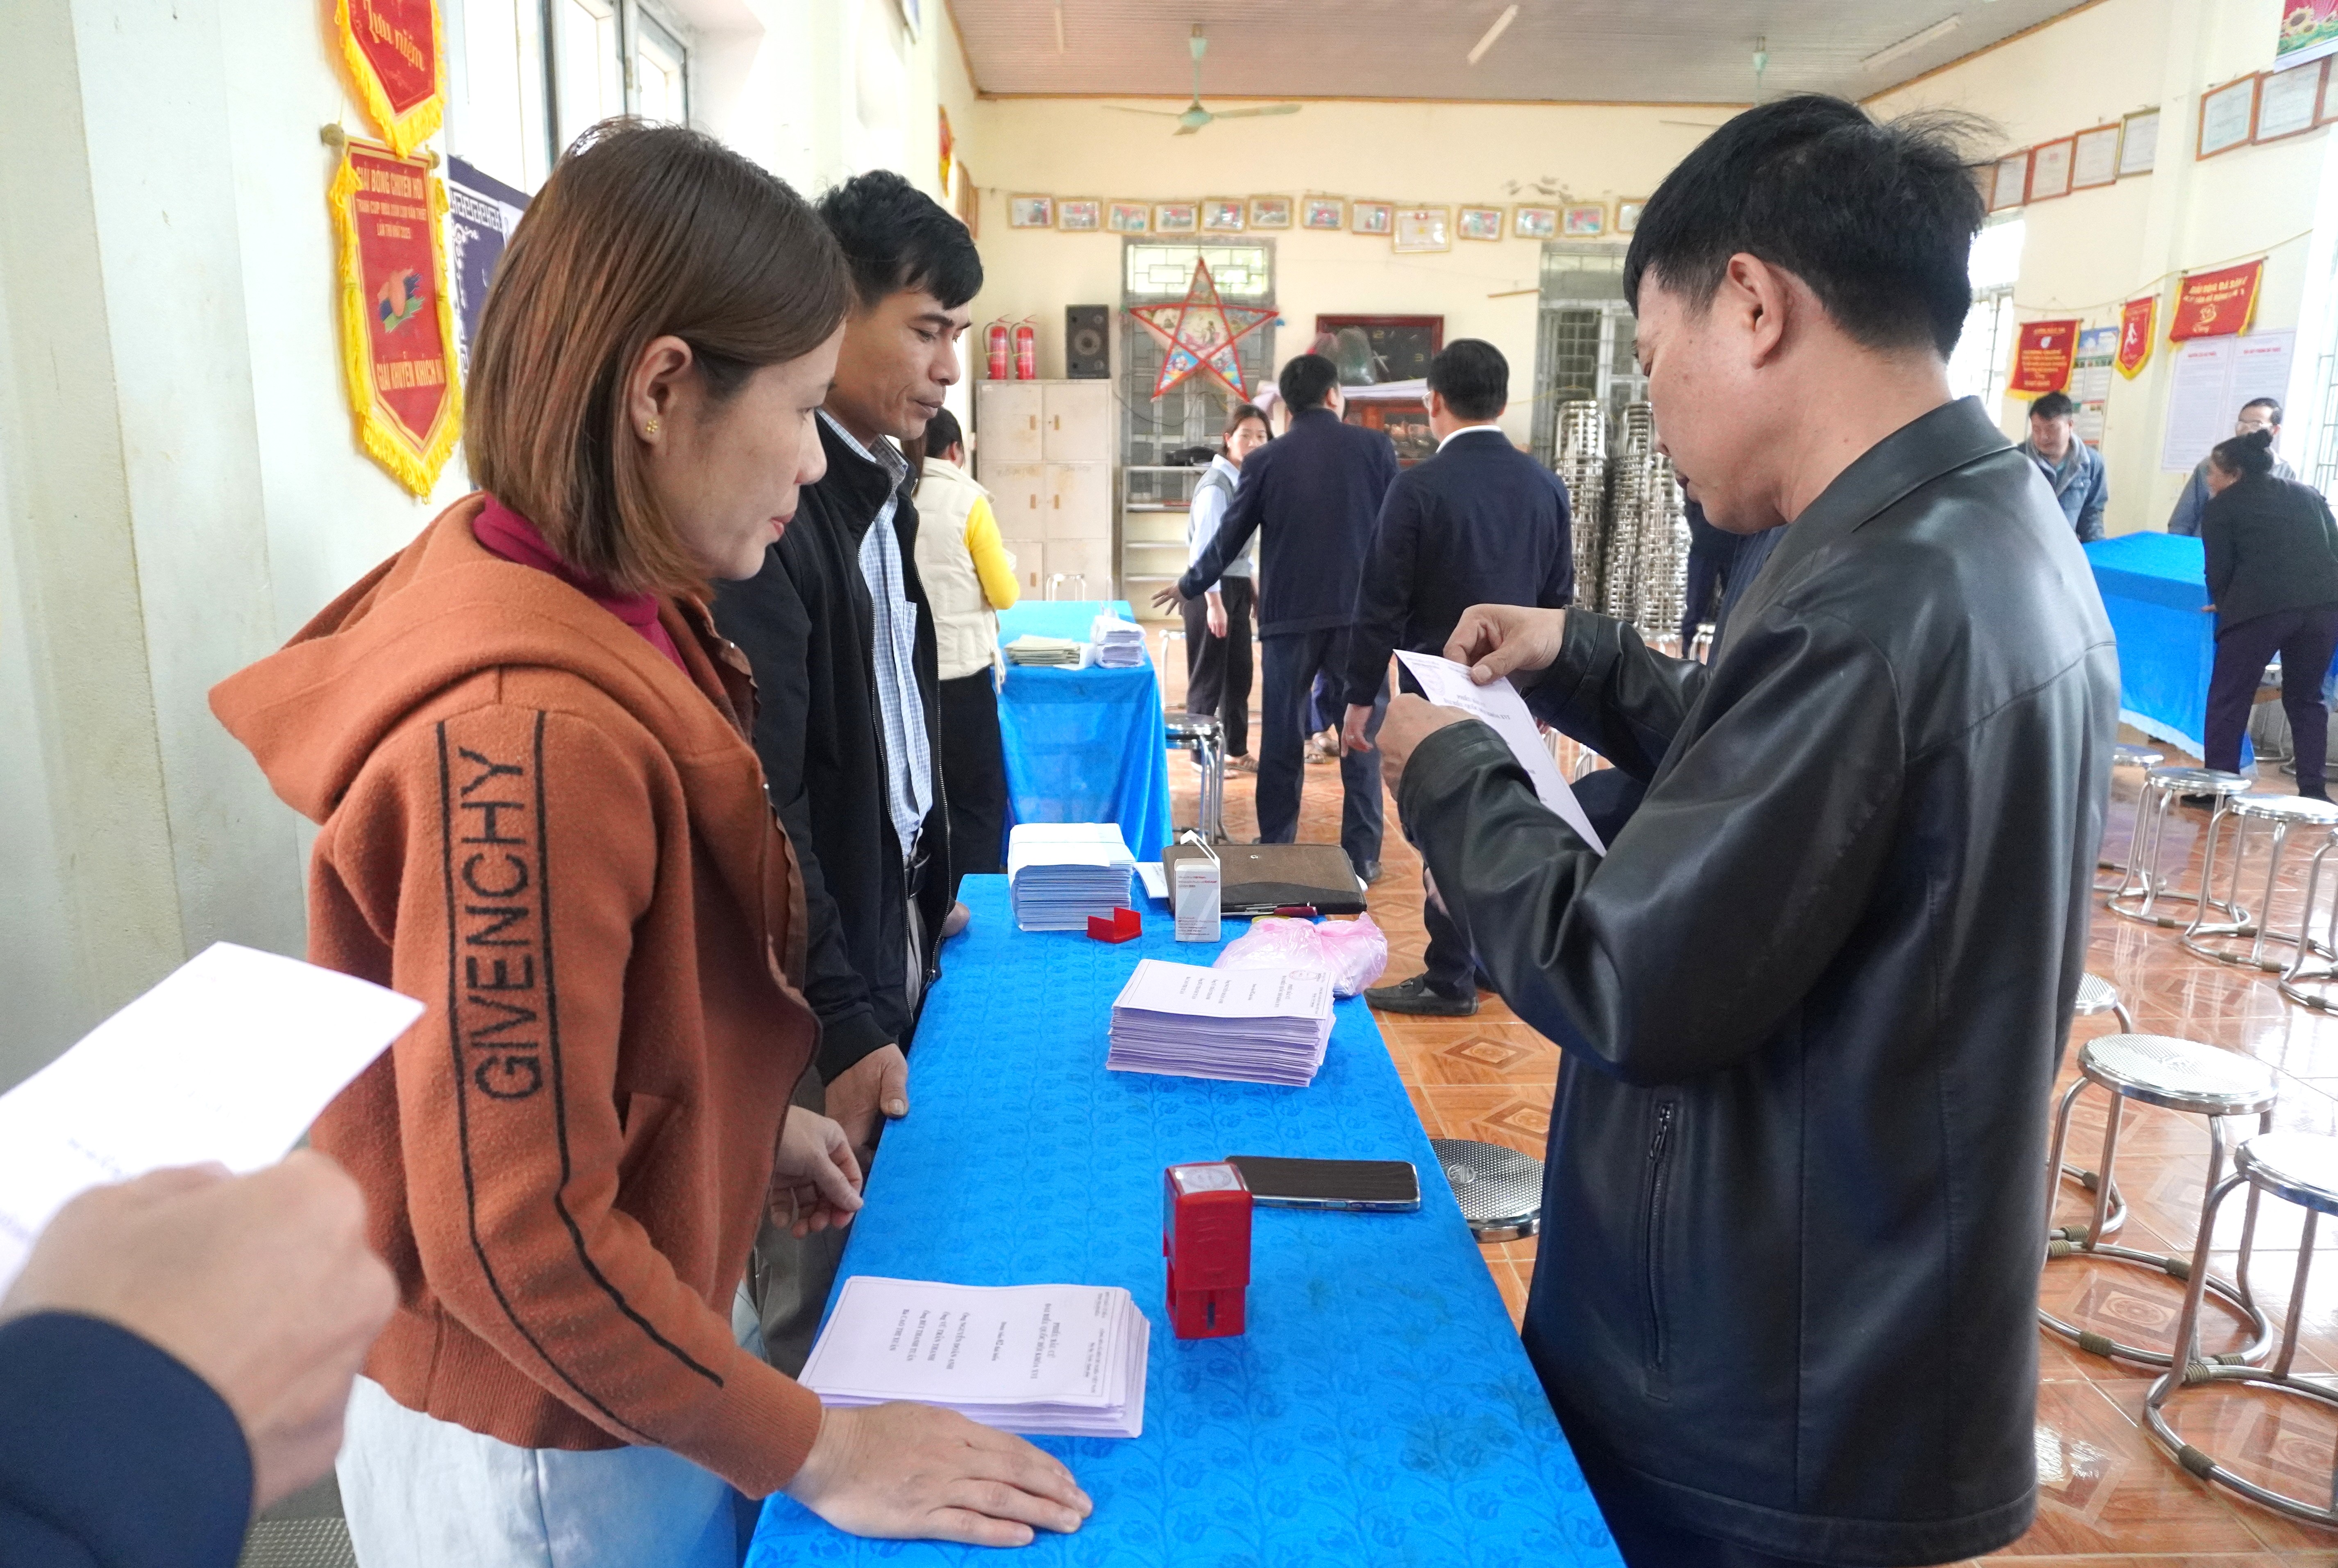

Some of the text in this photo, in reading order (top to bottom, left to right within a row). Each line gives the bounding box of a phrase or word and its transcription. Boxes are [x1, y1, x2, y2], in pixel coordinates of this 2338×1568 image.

[377, 355, 391, 391] GIẢI
[414, 353, 437, 387] KHÍCH
[459, 746, 543, 1099] GIVENCHY
